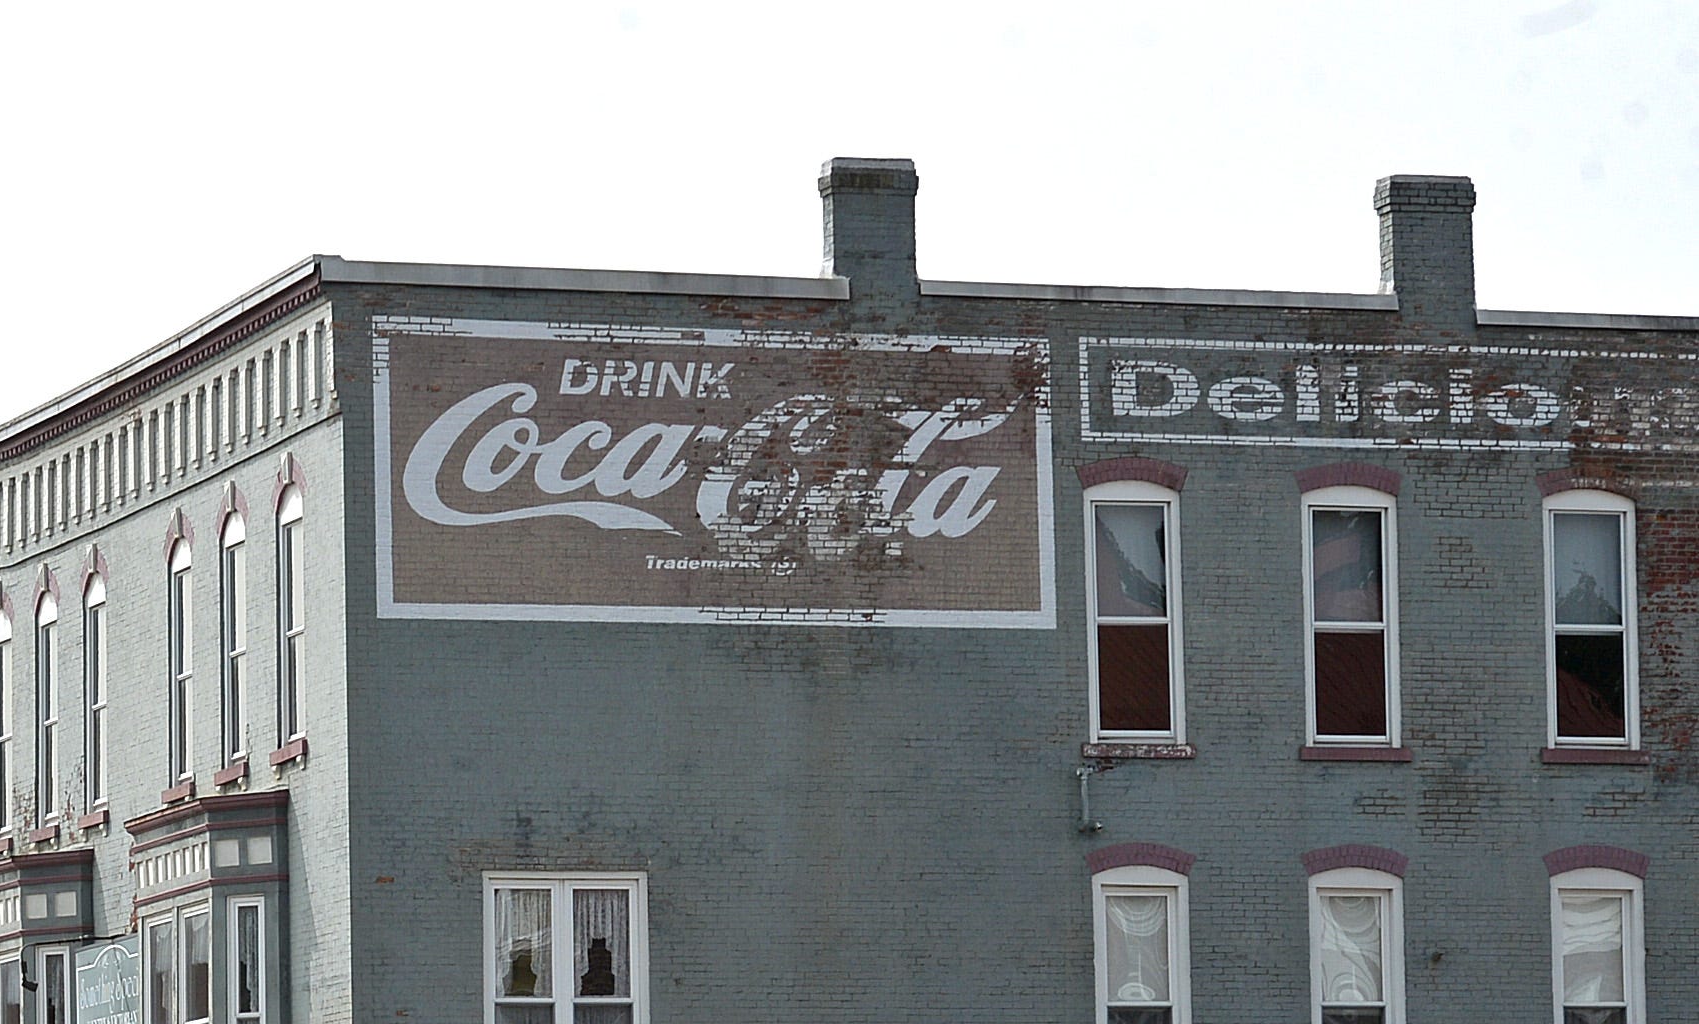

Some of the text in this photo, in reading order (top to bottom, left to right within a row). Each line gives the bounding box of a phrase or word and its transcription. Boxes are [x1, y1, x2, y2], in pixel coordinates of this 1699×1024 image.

[559, 357, 735, 401] DRINK
[1110, 358, 1699, 431] Delicio
[115, 967, 139, 1011] Speci
